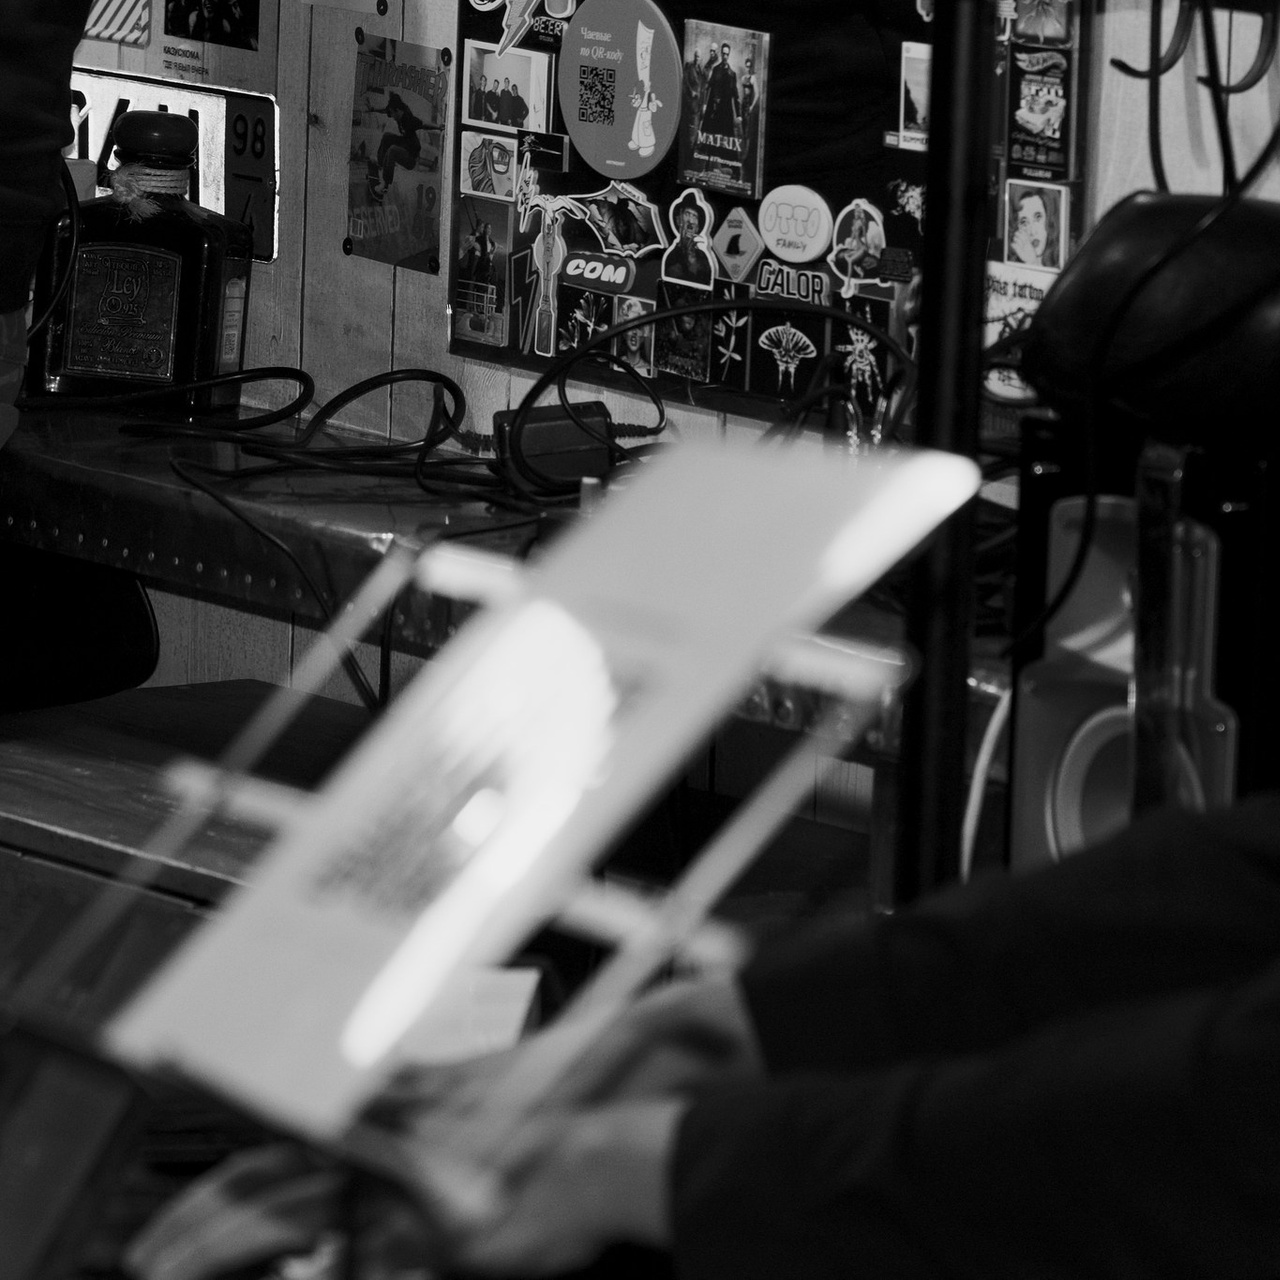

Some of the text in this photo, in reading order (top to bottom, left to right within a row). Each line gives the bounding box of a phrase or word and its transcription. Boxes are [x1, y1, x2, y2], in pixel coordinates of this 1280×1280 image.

[581, 27, 612, 42] Чаевые
[580, 46, 624, 63] по QR-коду
[231, 112, 267, 161] 98
[697, 130, 743, 152] MATRIX
[763, 202, 820, 238] OTTO
[776, 238, 808, 252] FAMILY
[111, 269, 142, 302] Ley
[758, 260, 824, 305] GALOR
